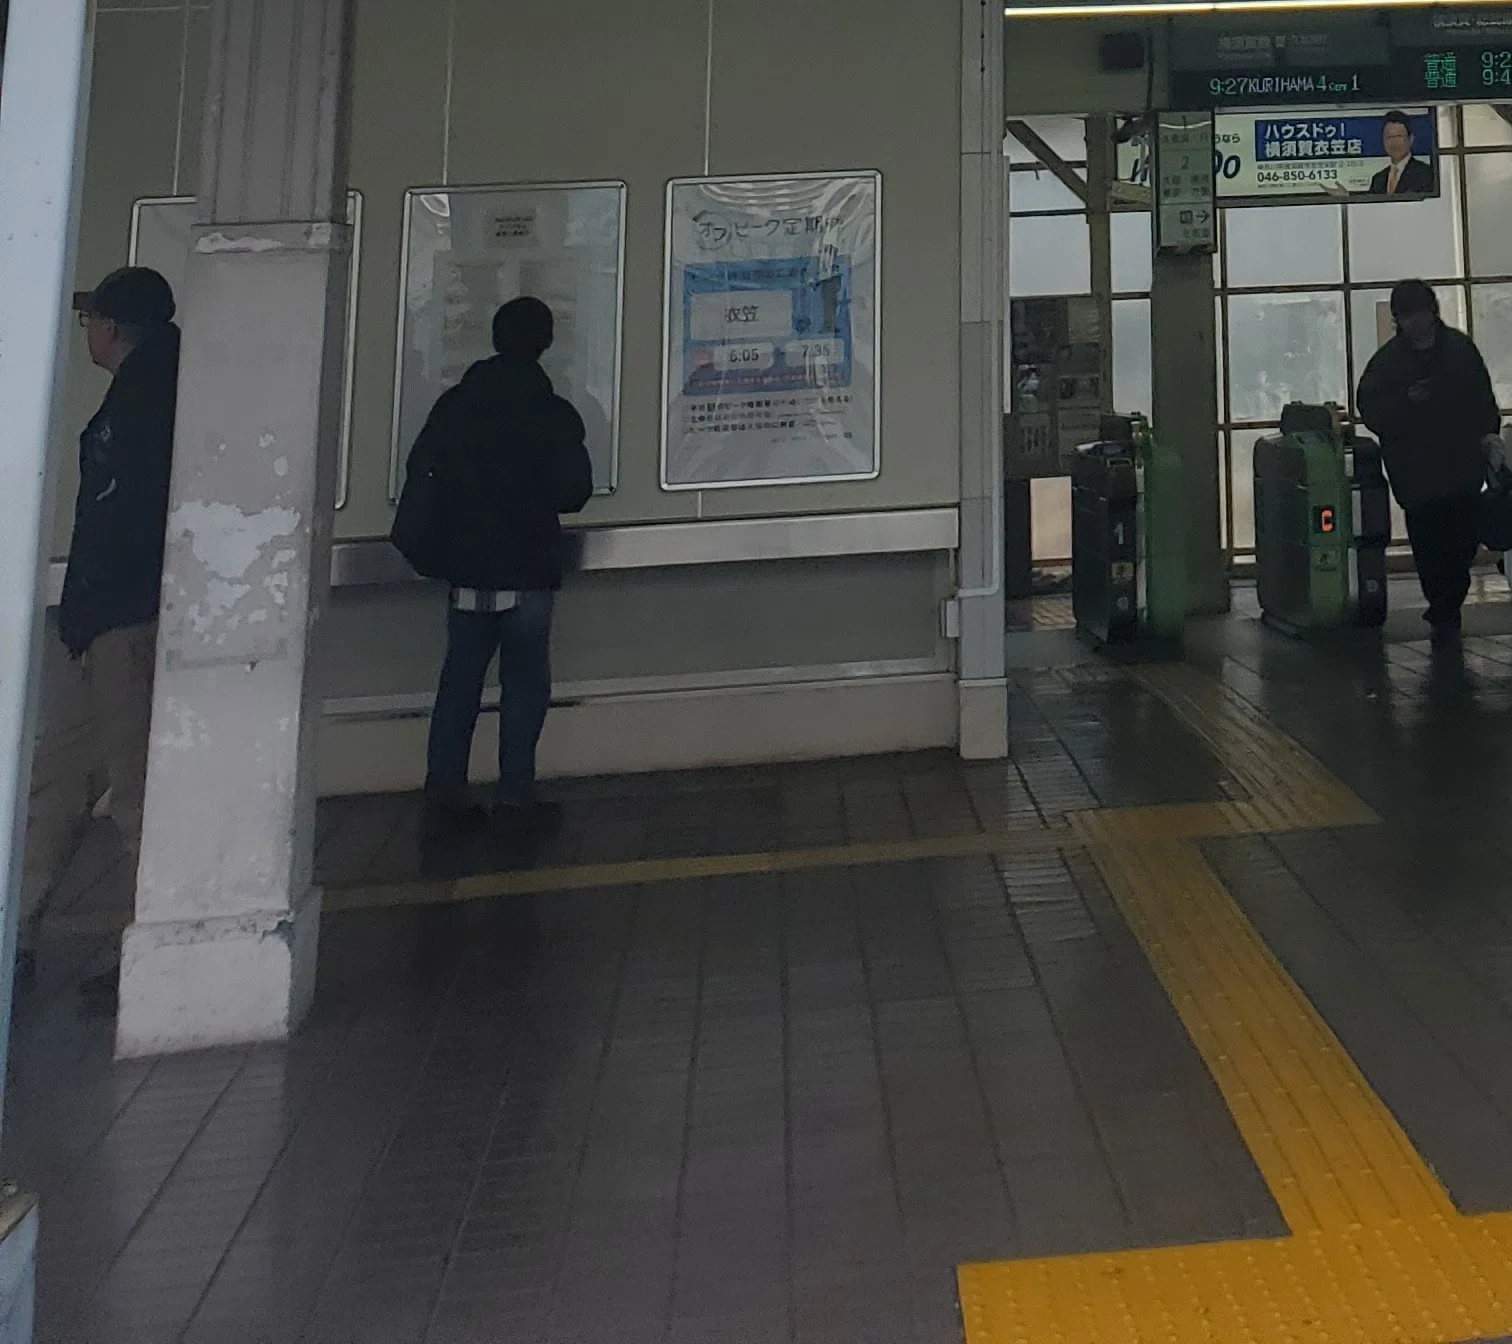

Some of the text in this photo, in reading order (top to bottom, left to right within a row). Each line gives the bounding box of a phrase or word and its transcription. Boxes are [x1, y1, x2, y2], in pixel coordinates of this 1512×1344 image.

[1264, 139, 1362, 158] 横須賀衣笠店
[1257, 169, 1338, 184] 046-850-6133
